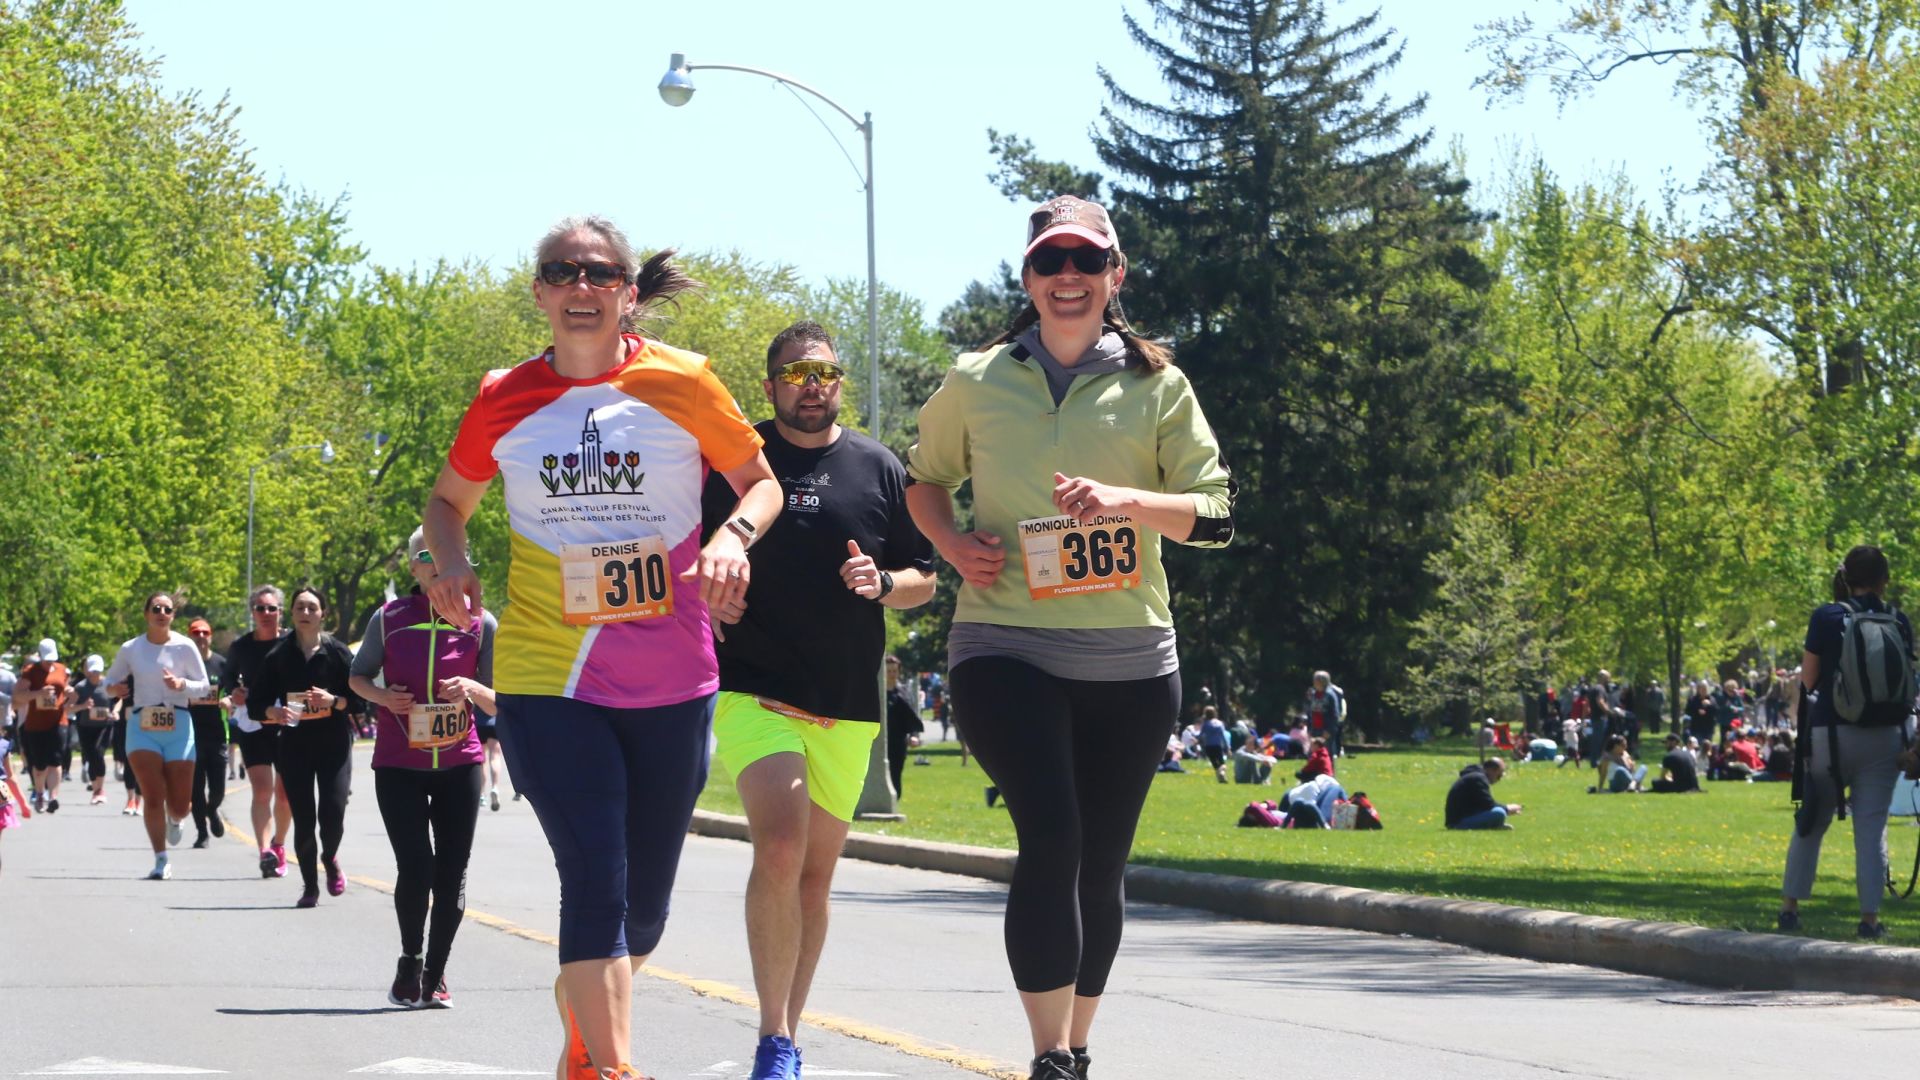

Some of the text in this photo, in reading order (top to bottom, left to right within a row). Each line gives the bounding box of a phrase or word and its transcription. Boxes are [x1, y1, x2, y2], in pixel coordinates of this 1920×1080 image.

[635, 514, 666, 522] TULIPES
[1025, 514, 1132, 534] MONIQUE IDINGA
[592, 543, 640, 557] DENISE
[1063, 527, 1136, 580] 363
[604, 553, 666, 607] 310
[590, 613, 617, 621] FLOWER
[425, 705, 456, 713] BRENDA
[152, 712, 174, 727] 356
[432, 709, 467, 739] 460
